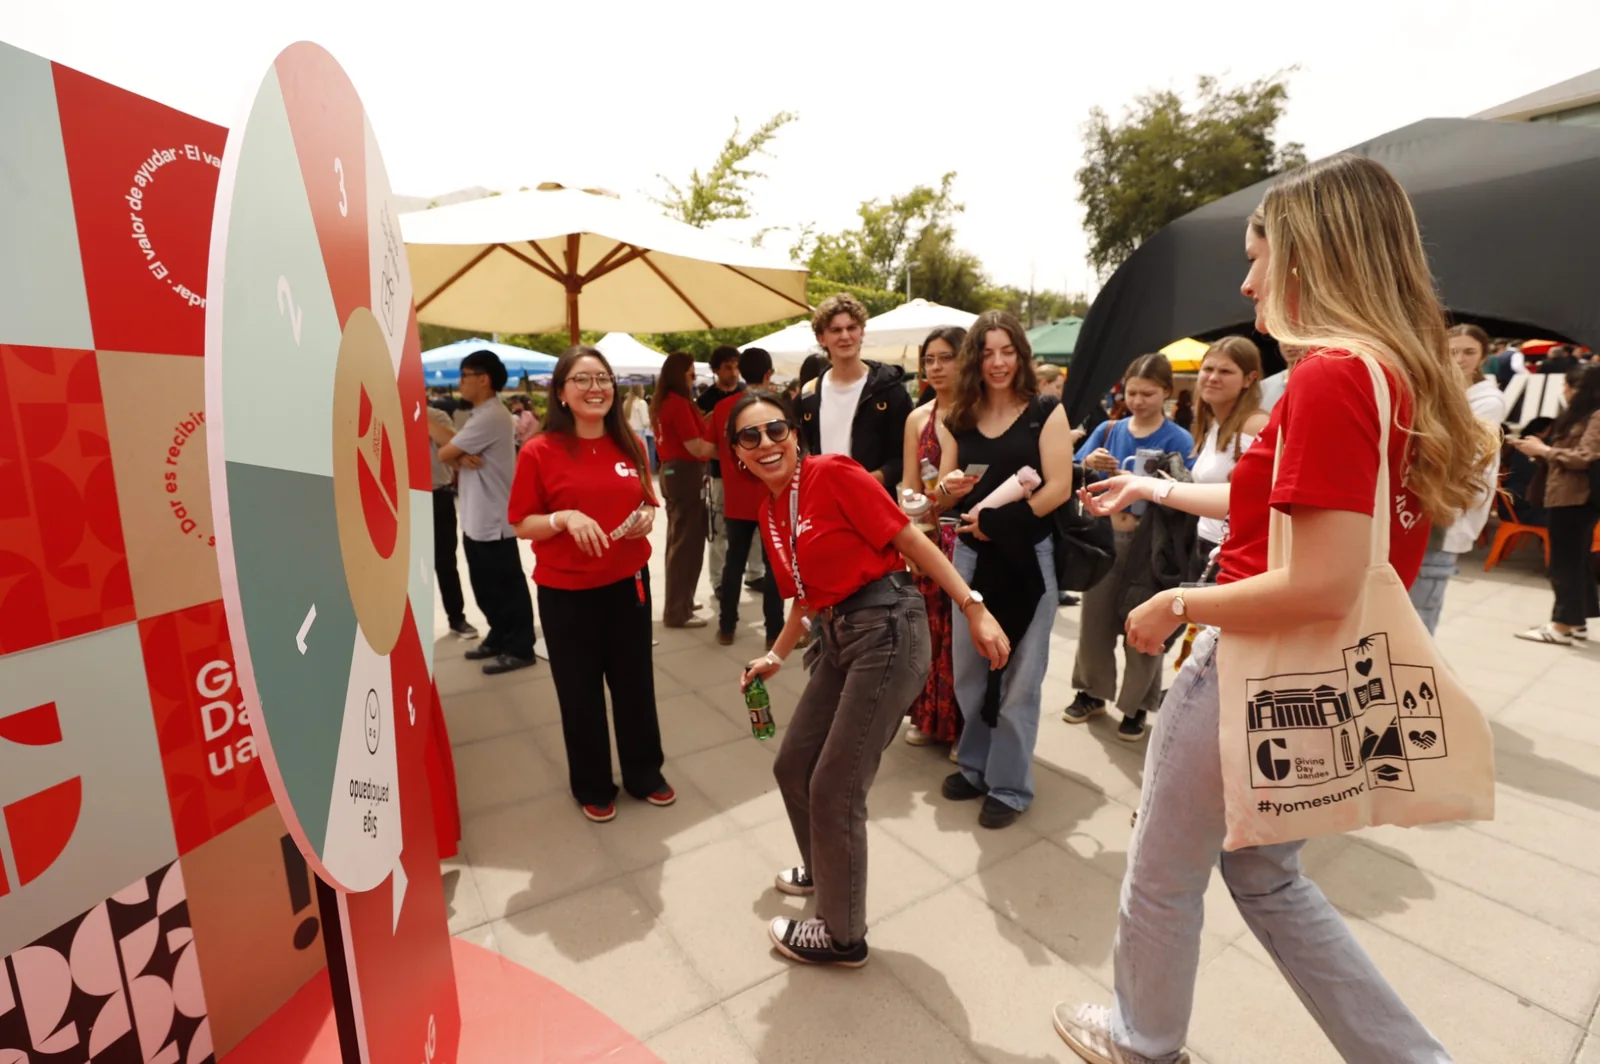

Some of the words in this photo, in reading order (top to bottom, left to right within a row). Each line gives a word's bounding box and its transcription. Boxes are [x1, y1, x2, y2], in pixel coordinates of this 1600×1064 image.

[184, 143, 201, 161] El
[133, 148, 177, 183] ayudar
[125, 186, 144, 211] de
[131, 212, 156, 260] valor
[148, 261, 169, 280] El
[277, 275, 303, 347] 2
[166, 411, 206, 466] recibir
[165, 472, 178, 494] es
[170, 500, 197, 535] Dar
[196, 659, 239, 699] G
[1295, 758, 1325, 767] Giving
[1296, 765, 1314, 774] Day
[1297, 771, 1330, 780] uandes
